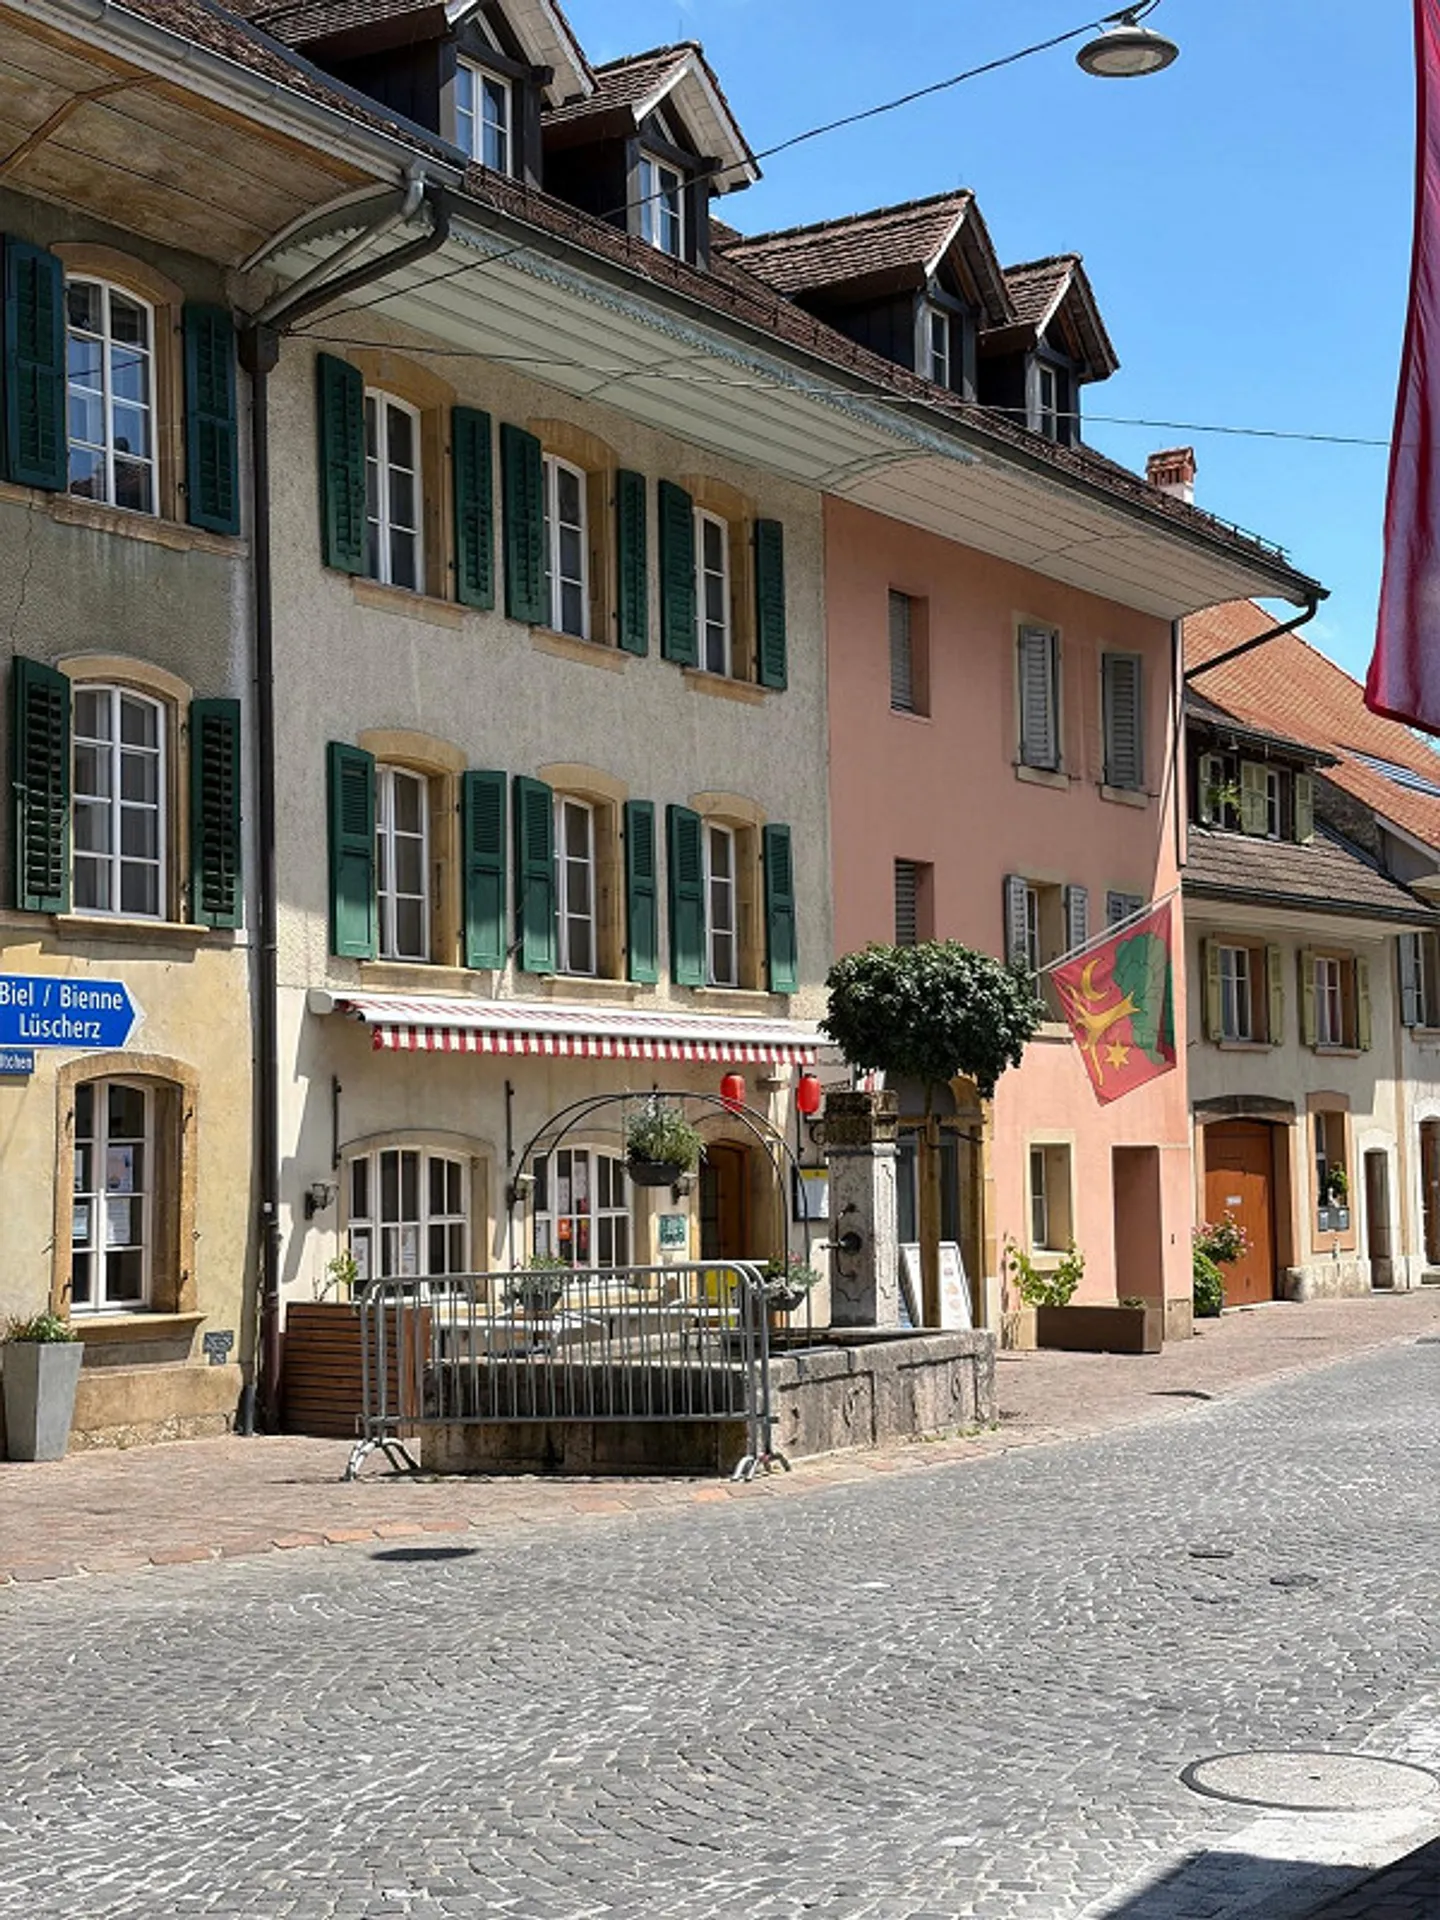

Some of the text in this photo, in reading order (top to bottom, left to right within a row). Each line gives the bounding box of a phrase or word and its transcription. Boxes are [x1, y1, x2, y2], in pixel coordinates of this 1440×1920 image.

[0, 981, 123, 1010] Biel / Bienne
[19, 1012, 102, 1039] Lüscherz
